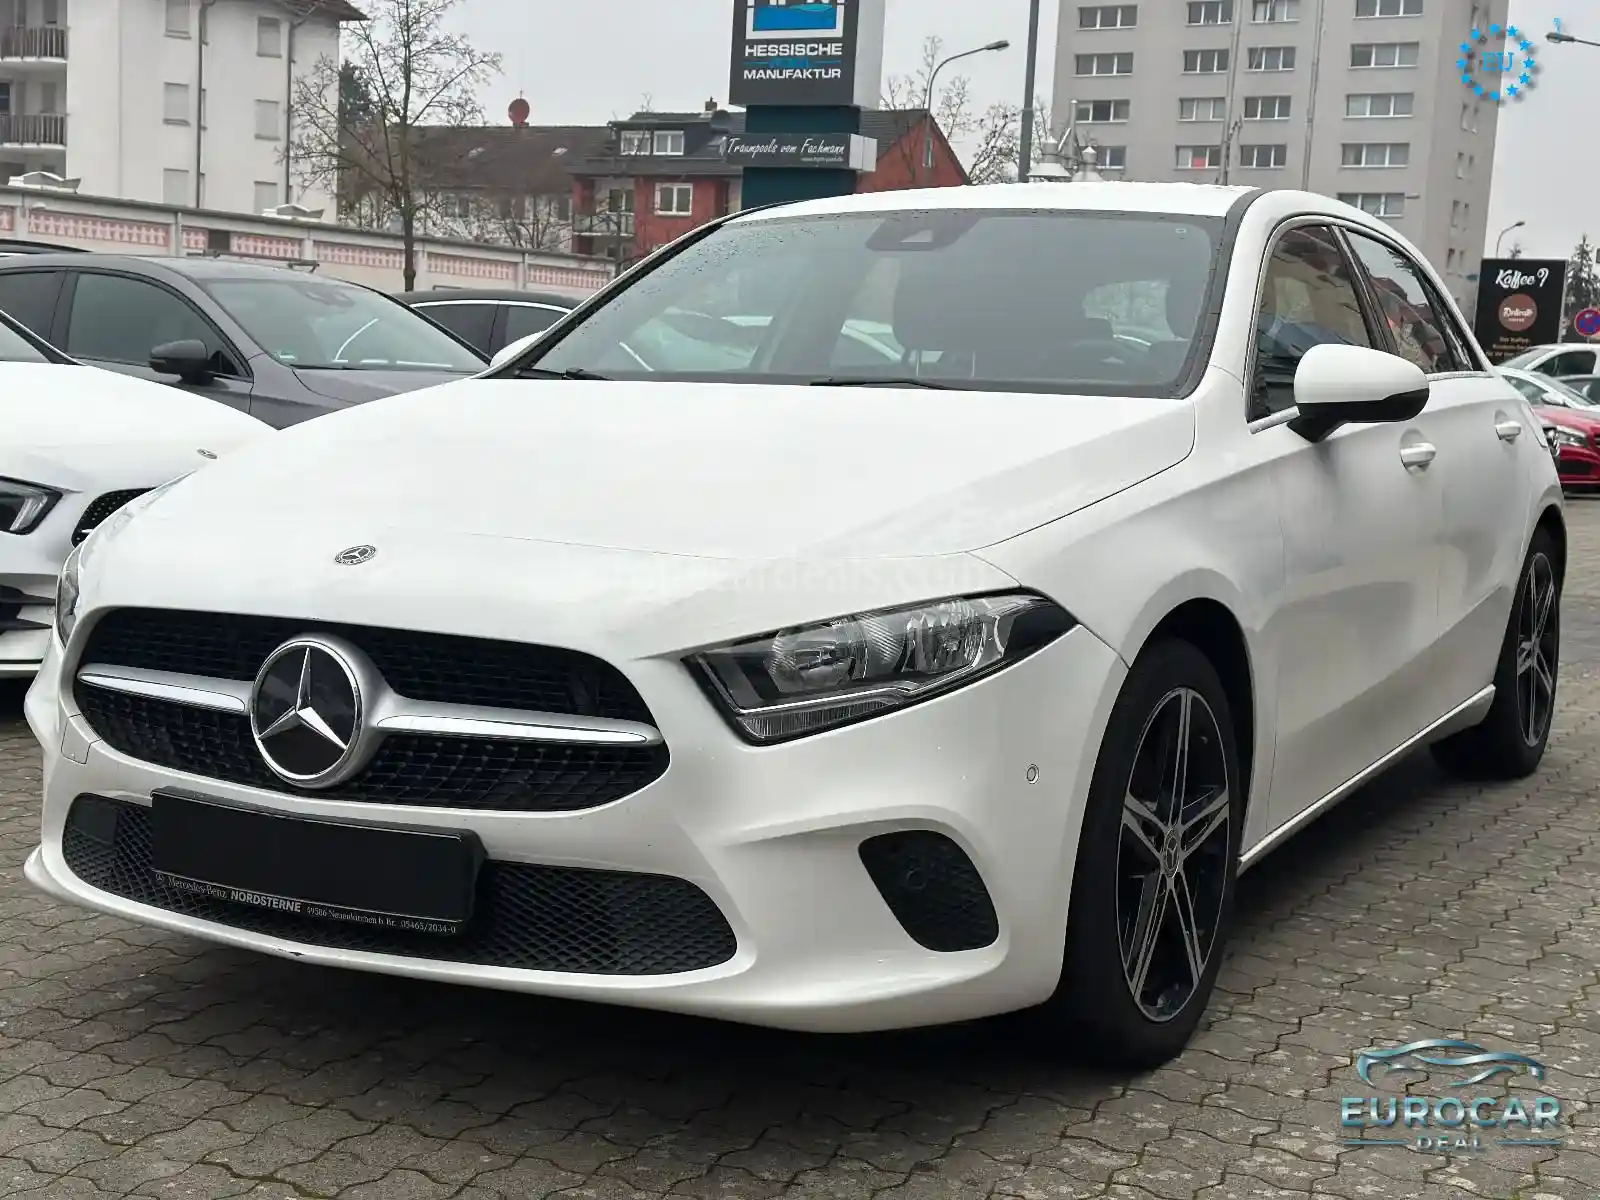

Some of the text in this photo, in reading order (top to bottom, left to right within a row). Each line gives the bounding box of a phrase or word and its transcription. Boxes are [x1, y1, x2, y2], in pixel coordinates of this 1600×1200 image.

[744, 43, 843, 57] HESSISCHE
[743, 68, 842, 80] MANUFAKTUR
[728, 137, 845, 158] Traumpools vom Fachmann
[230, 889, 301, 913] NORDSTERNE
